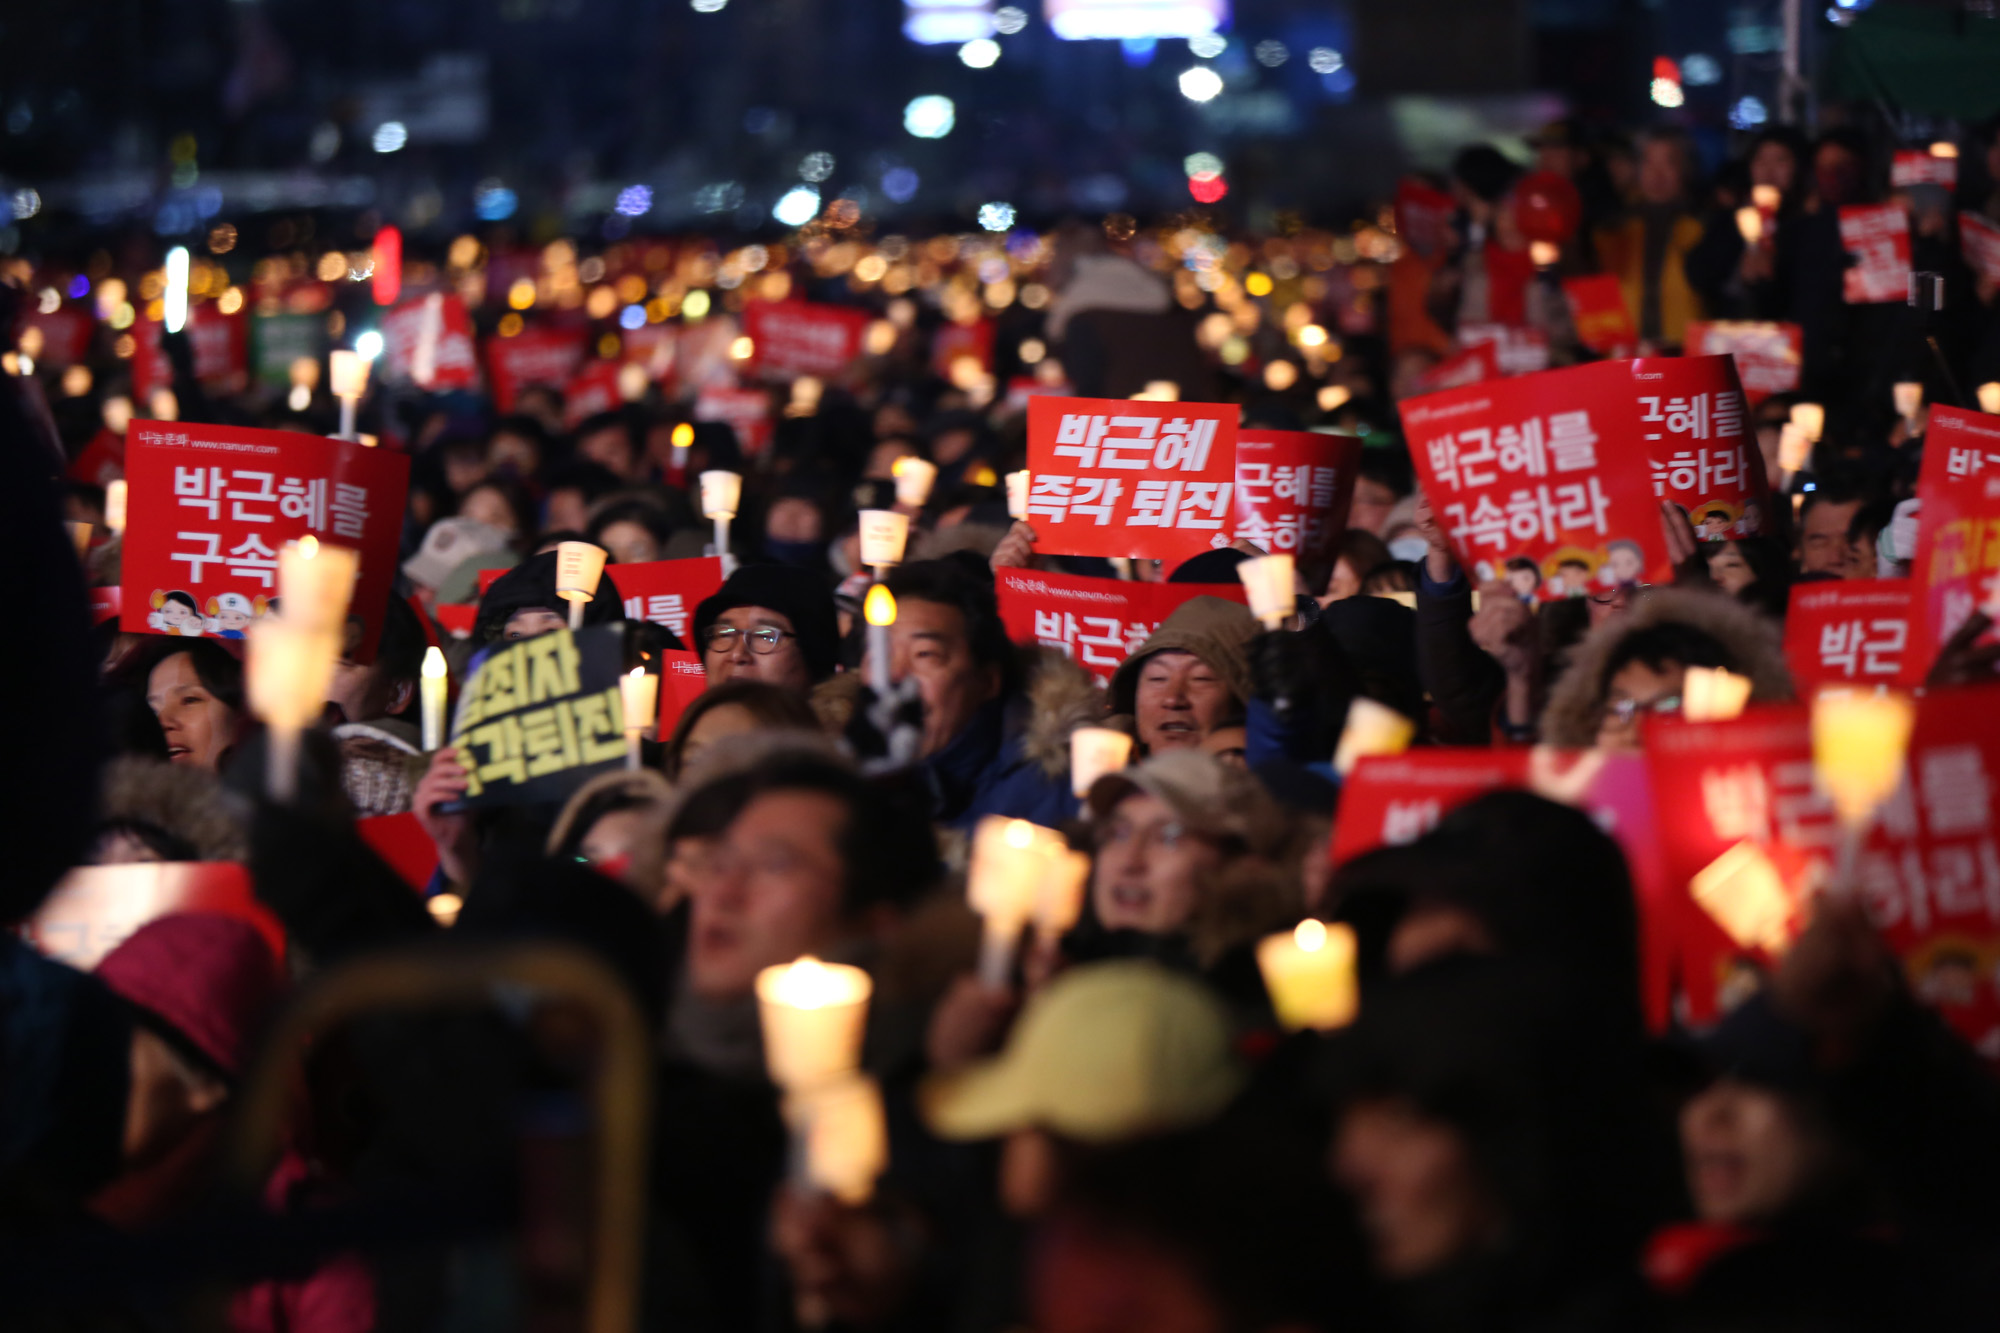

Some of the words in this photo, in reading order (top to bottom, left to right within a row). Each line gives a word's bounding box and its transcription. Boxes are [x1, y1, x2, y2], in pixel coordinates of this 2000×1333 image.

[190, 439, 279, 454] www.nanum.com
[1053, 414, 1219, 471] 박근혜
[1427, 410, 1598, 492] 박근혜를
[174, 466, 371, 538] 박근혜를
[1028, 474, 1124, 526] 즉각
[1125, 480, 1234, 530] 퇴진
[170, 531, 300, 588] 구속
[458, 628, 581, 735] 죄자
[1700, 745, 1992, 848] 박근를
